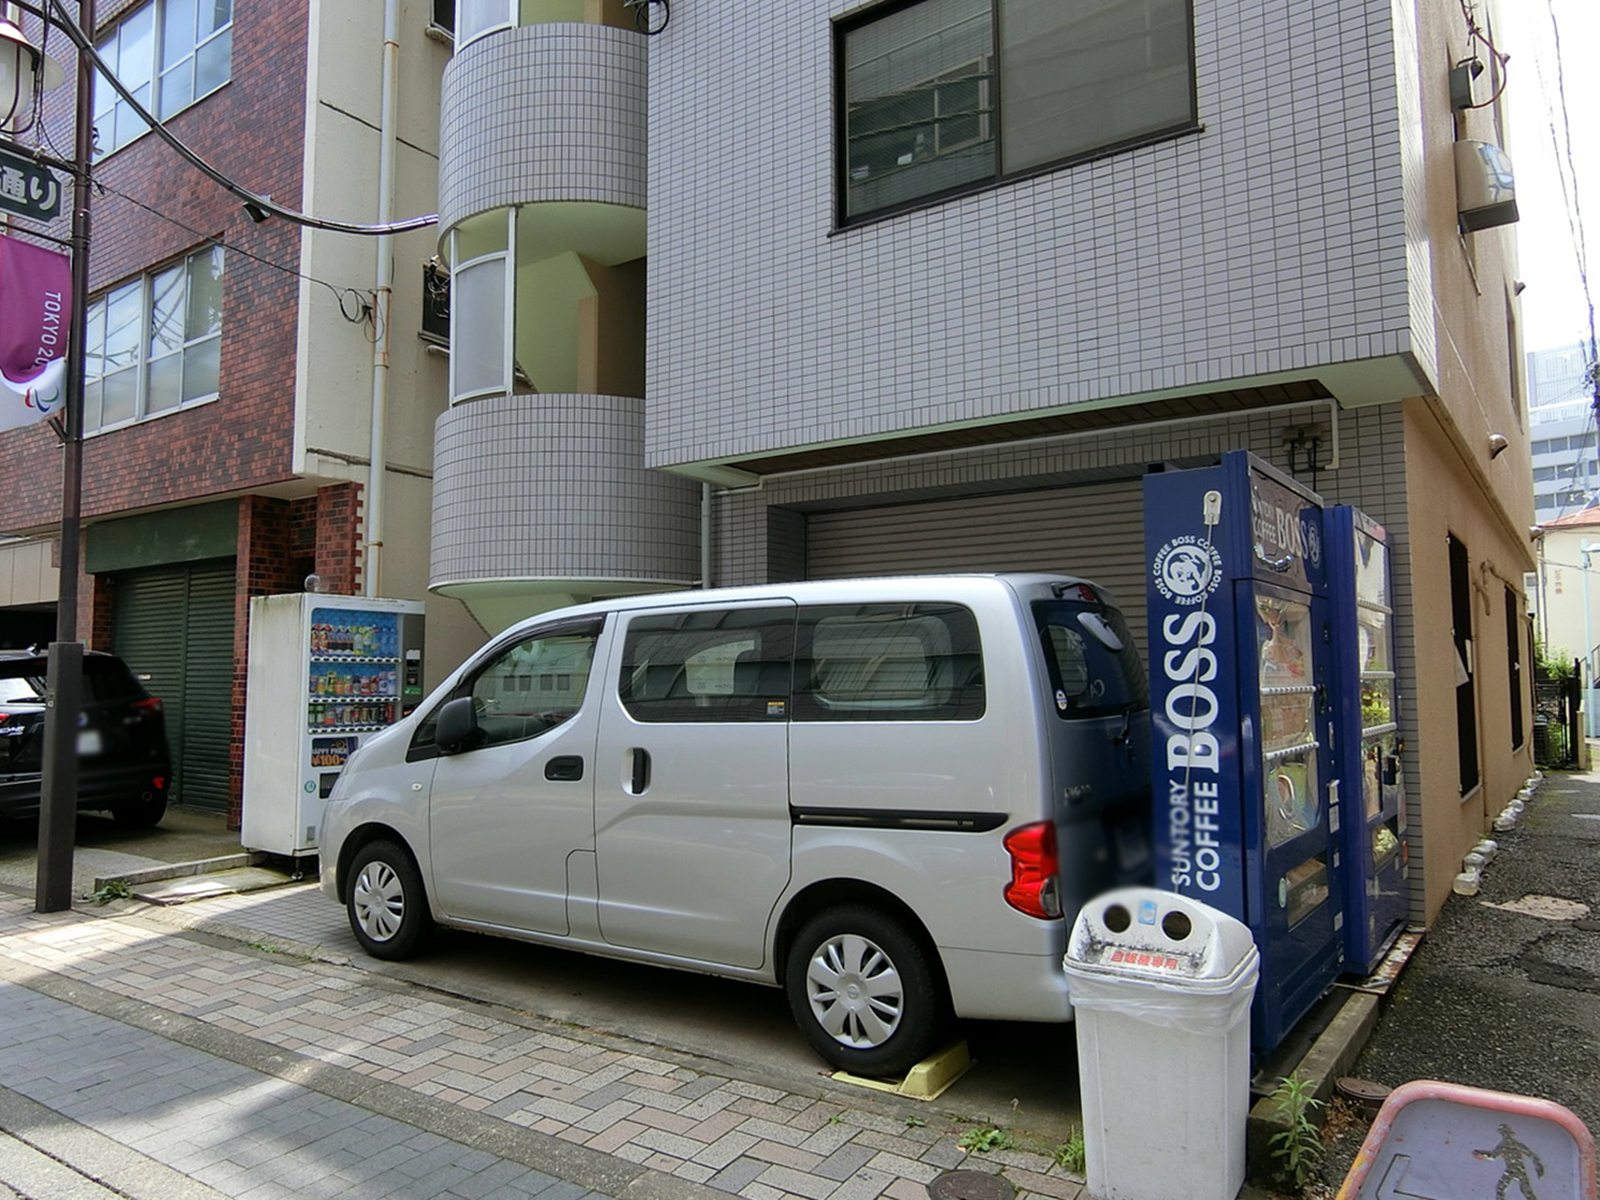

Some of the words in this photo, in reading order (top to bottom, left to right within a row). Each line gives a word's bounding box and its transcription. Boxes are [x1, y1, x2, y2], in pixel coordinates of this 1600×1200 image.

[41, 292, 61, 345] TOKYO
[1171, 535, 1195, 547] BOSS
[1254, 517, 1277, 544] COFFEE
[1276, 507, 1308, 560] BOSS
[1152, 543, 1172, 576] COFFEE
[1197, 538, 1222, 566] COFFEE
[1154, 577, 1173, 600] BOSS
[1207, 569, 1222, 593] BOSS
[1163, 611, 1219, 774] BOSS
[1169, 779, 1191, 887] SUNTORY
[1194, 782, 1221, 891] COFFEE
